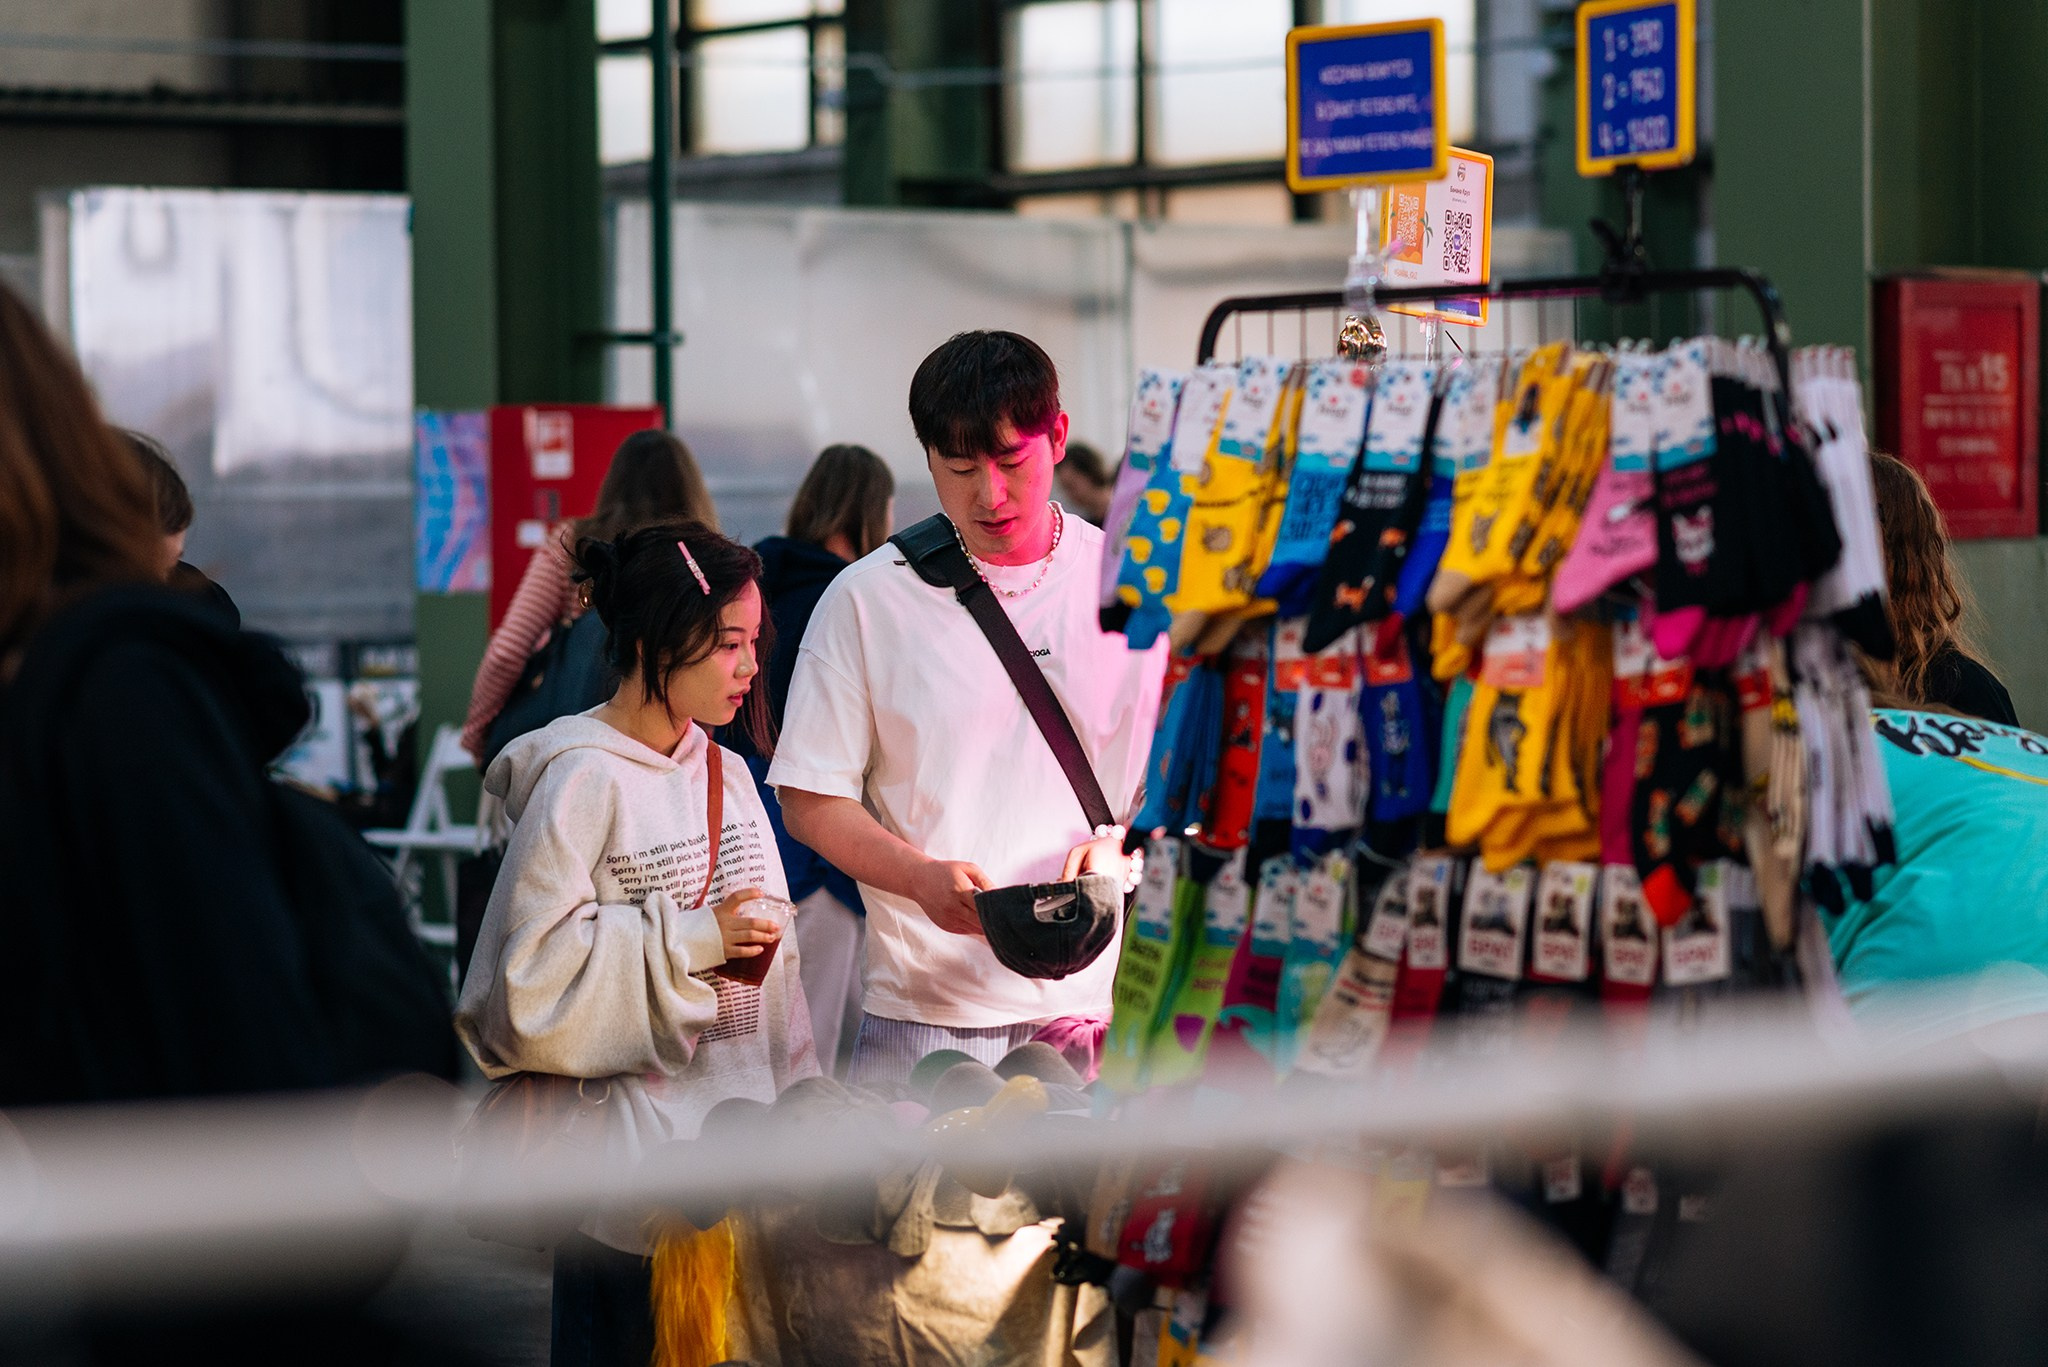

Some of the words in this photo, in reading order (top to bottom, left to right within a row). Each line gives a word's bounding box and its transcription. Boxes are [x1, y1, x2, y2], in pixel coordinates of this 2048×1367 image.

[606, 854, 631, 864] Sorry
[650, 844, 668, 856] still
[670, 840, 687, 851] pick
[721, 823, 738, 834] ade
[611, 866, 637, 876] Sorry
[657, 856, 674, 868] still
[676, 852, 692, 864] pick
[618, 876, 642, 886] Sorry
[645, 873, 659, 883] i'm
[662, 868, 678, 880] still
[680, 865, 695, 876] pick
[720, 844, 745, 858] made
[623, 886, 648, 896] Sorry
[665, 879, 680, 892] still
